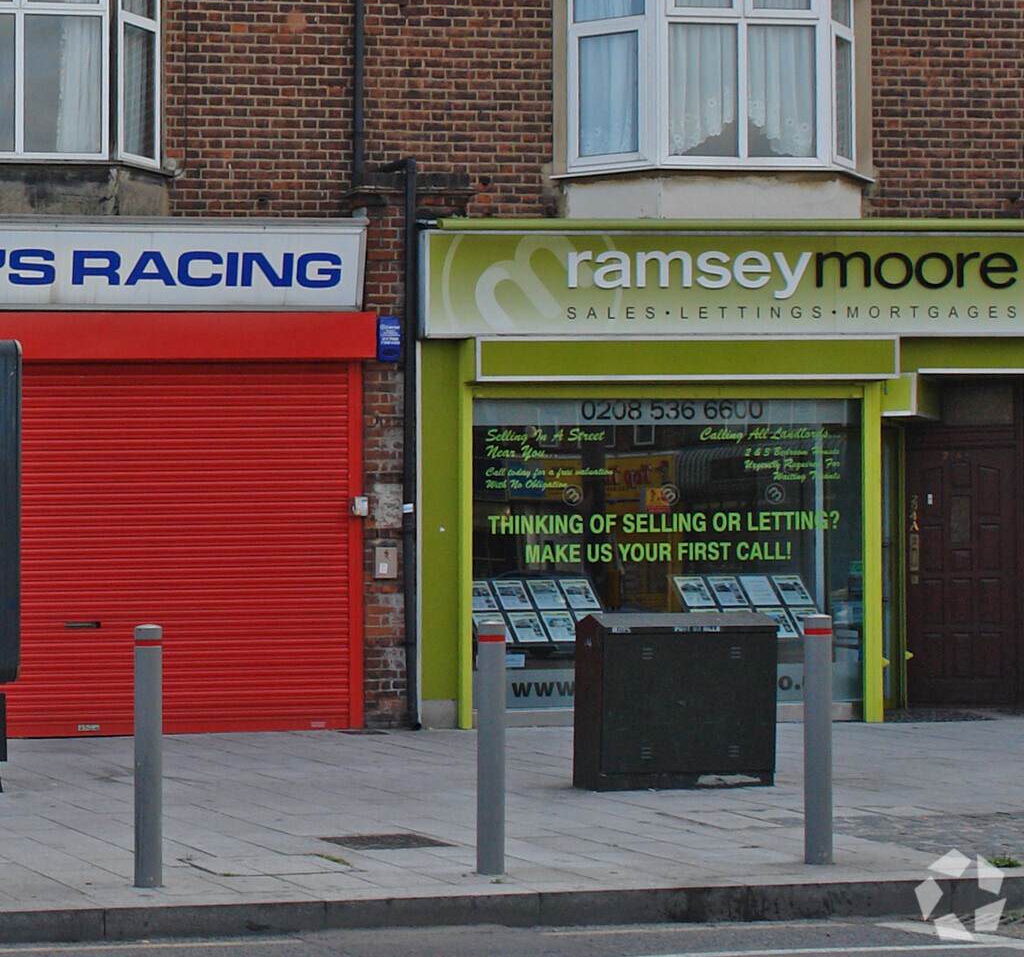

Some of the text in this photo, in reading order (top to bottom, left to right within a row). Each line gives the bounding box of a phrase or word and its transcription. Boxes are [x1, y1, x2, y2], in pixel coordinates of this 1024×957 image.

[71, 248, 343, 289] RACING
[581, 399, 764, 421] 0208 536 6600
[485, 428, 606, 444] Selling In A Street
[700, 427, 744, 443] Calling
[747, 427, 768, 440] All
[485, 445, 516, 459] Near
[485, 467, 506, 477] Call
[507, 467, 531, 478] today
[485, 479, 507, 489] With
[508, 479, 523, 489] No
[488, 510, 840, 534] THINKING OF SELLING OR LETTING?
[525, 541, 792, 564] MAKE US YOUR FIRST CALL!
